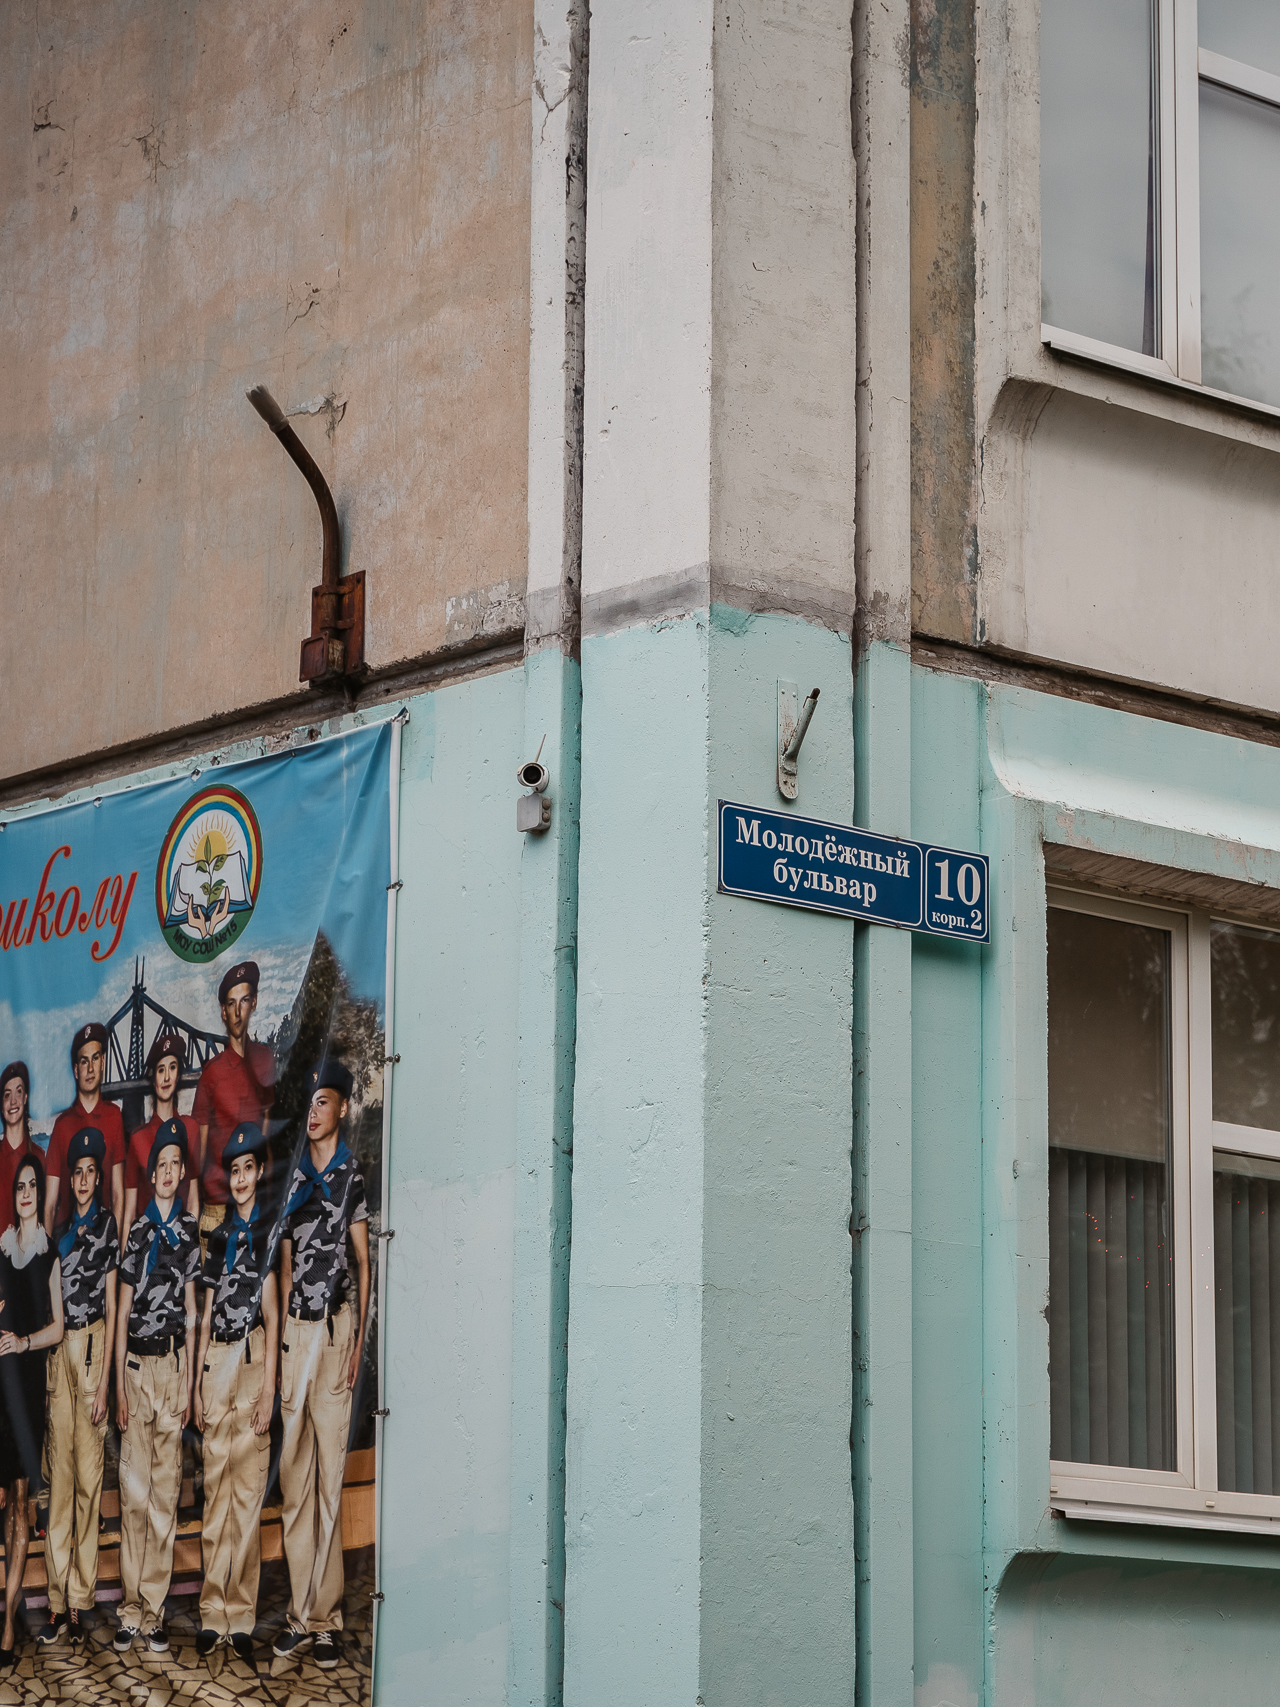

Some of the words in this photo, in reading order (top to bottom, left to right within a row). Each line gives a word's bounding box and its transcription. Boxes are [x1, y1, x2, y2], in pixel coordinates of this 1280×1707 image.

[735, 815, 911, 878] Молодёжный
[773, 857, 878, 908] бульвар
[934, 858, 982, 906] 10
[173, 928, 193, 952] МОУ
[192, 934, 215, 955] СОШ
